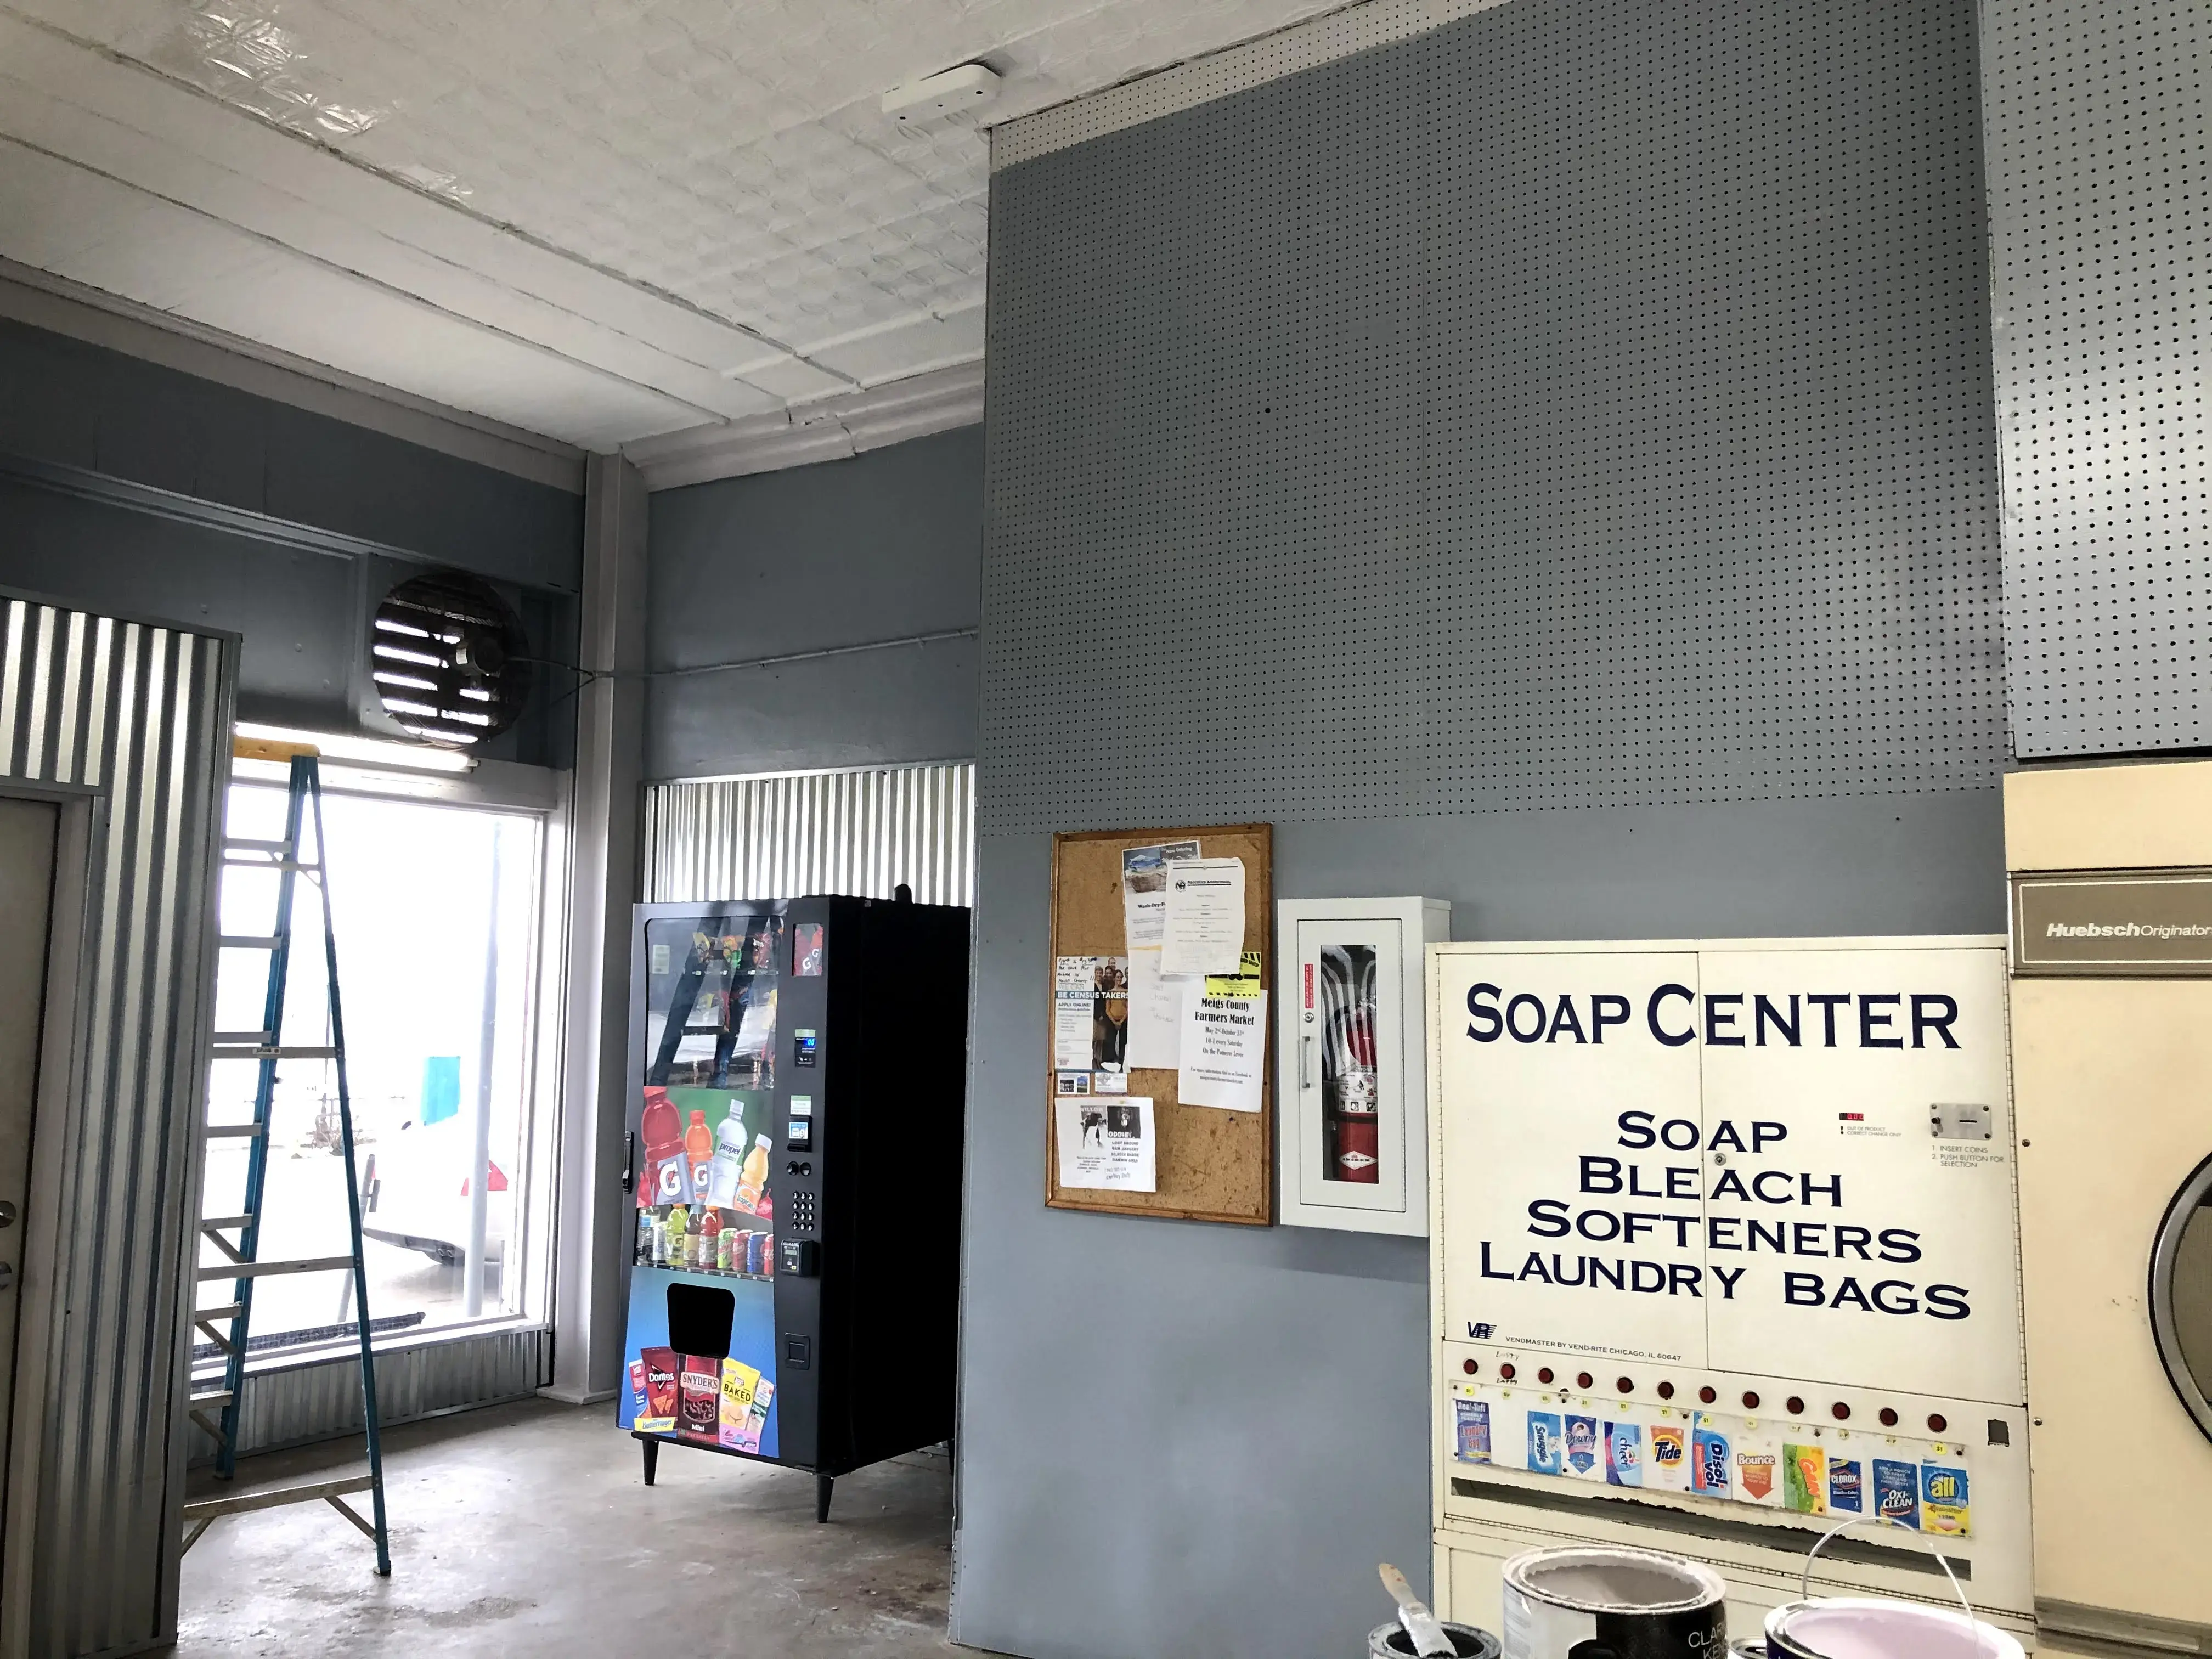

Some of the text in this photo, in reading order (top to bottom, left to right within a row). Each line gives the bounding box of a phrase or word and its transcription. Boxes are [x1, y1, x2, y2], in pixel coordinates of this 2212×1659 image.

[1201, 998, 1250, 1012] Meigs County
[1195, 1011, 1255, 1026] Farmers Market
[1466, 983, 1962, 1050] SOAP CENTER
[1618, 1110, 1788, 1153] SOAP
[719, 1143, 741, 1155] propel
[659, 1161, 681, 1197] G
[694, 1165, 708, 1187] G
[1578, 1155, 1843, 1207] BLEACH
[1527, 1199, 1922, 1263] SOFTENERS
[1479, 1241, 1972, 1320] LAUNDRY BAGS
[1505, 1336, 1556, 1347] VENDMASTER
[1568, 1343, 1607, 1353] VEND-RITE
[648, 1373, 674, 1383] Doritos
[682, 1374, 718, 1389] SNYDER'S
[724, 1383, 752, 1401] BAKED
[1460, 1424, 1487, 1437] Laundry
[1469, 1437, 1480, 1449] Bag
[1536, 1426, 1547, 1463] Snuggle
[1565, 1431, 1597, 1451] Downy
[1619, 1437, 1632, 1465] cheer
[1655, 1441, 1683, 1463] Tide
[1737, 1453, 1776, 1466] Bounce
[1831, 1474, 1858, 1483] CLOROX
[1931, 1476, 1956, 1497] all
[1882, 1497, 1913, 1509] CLEAN
[1688, 1622, 1725, 1648] CLAR
